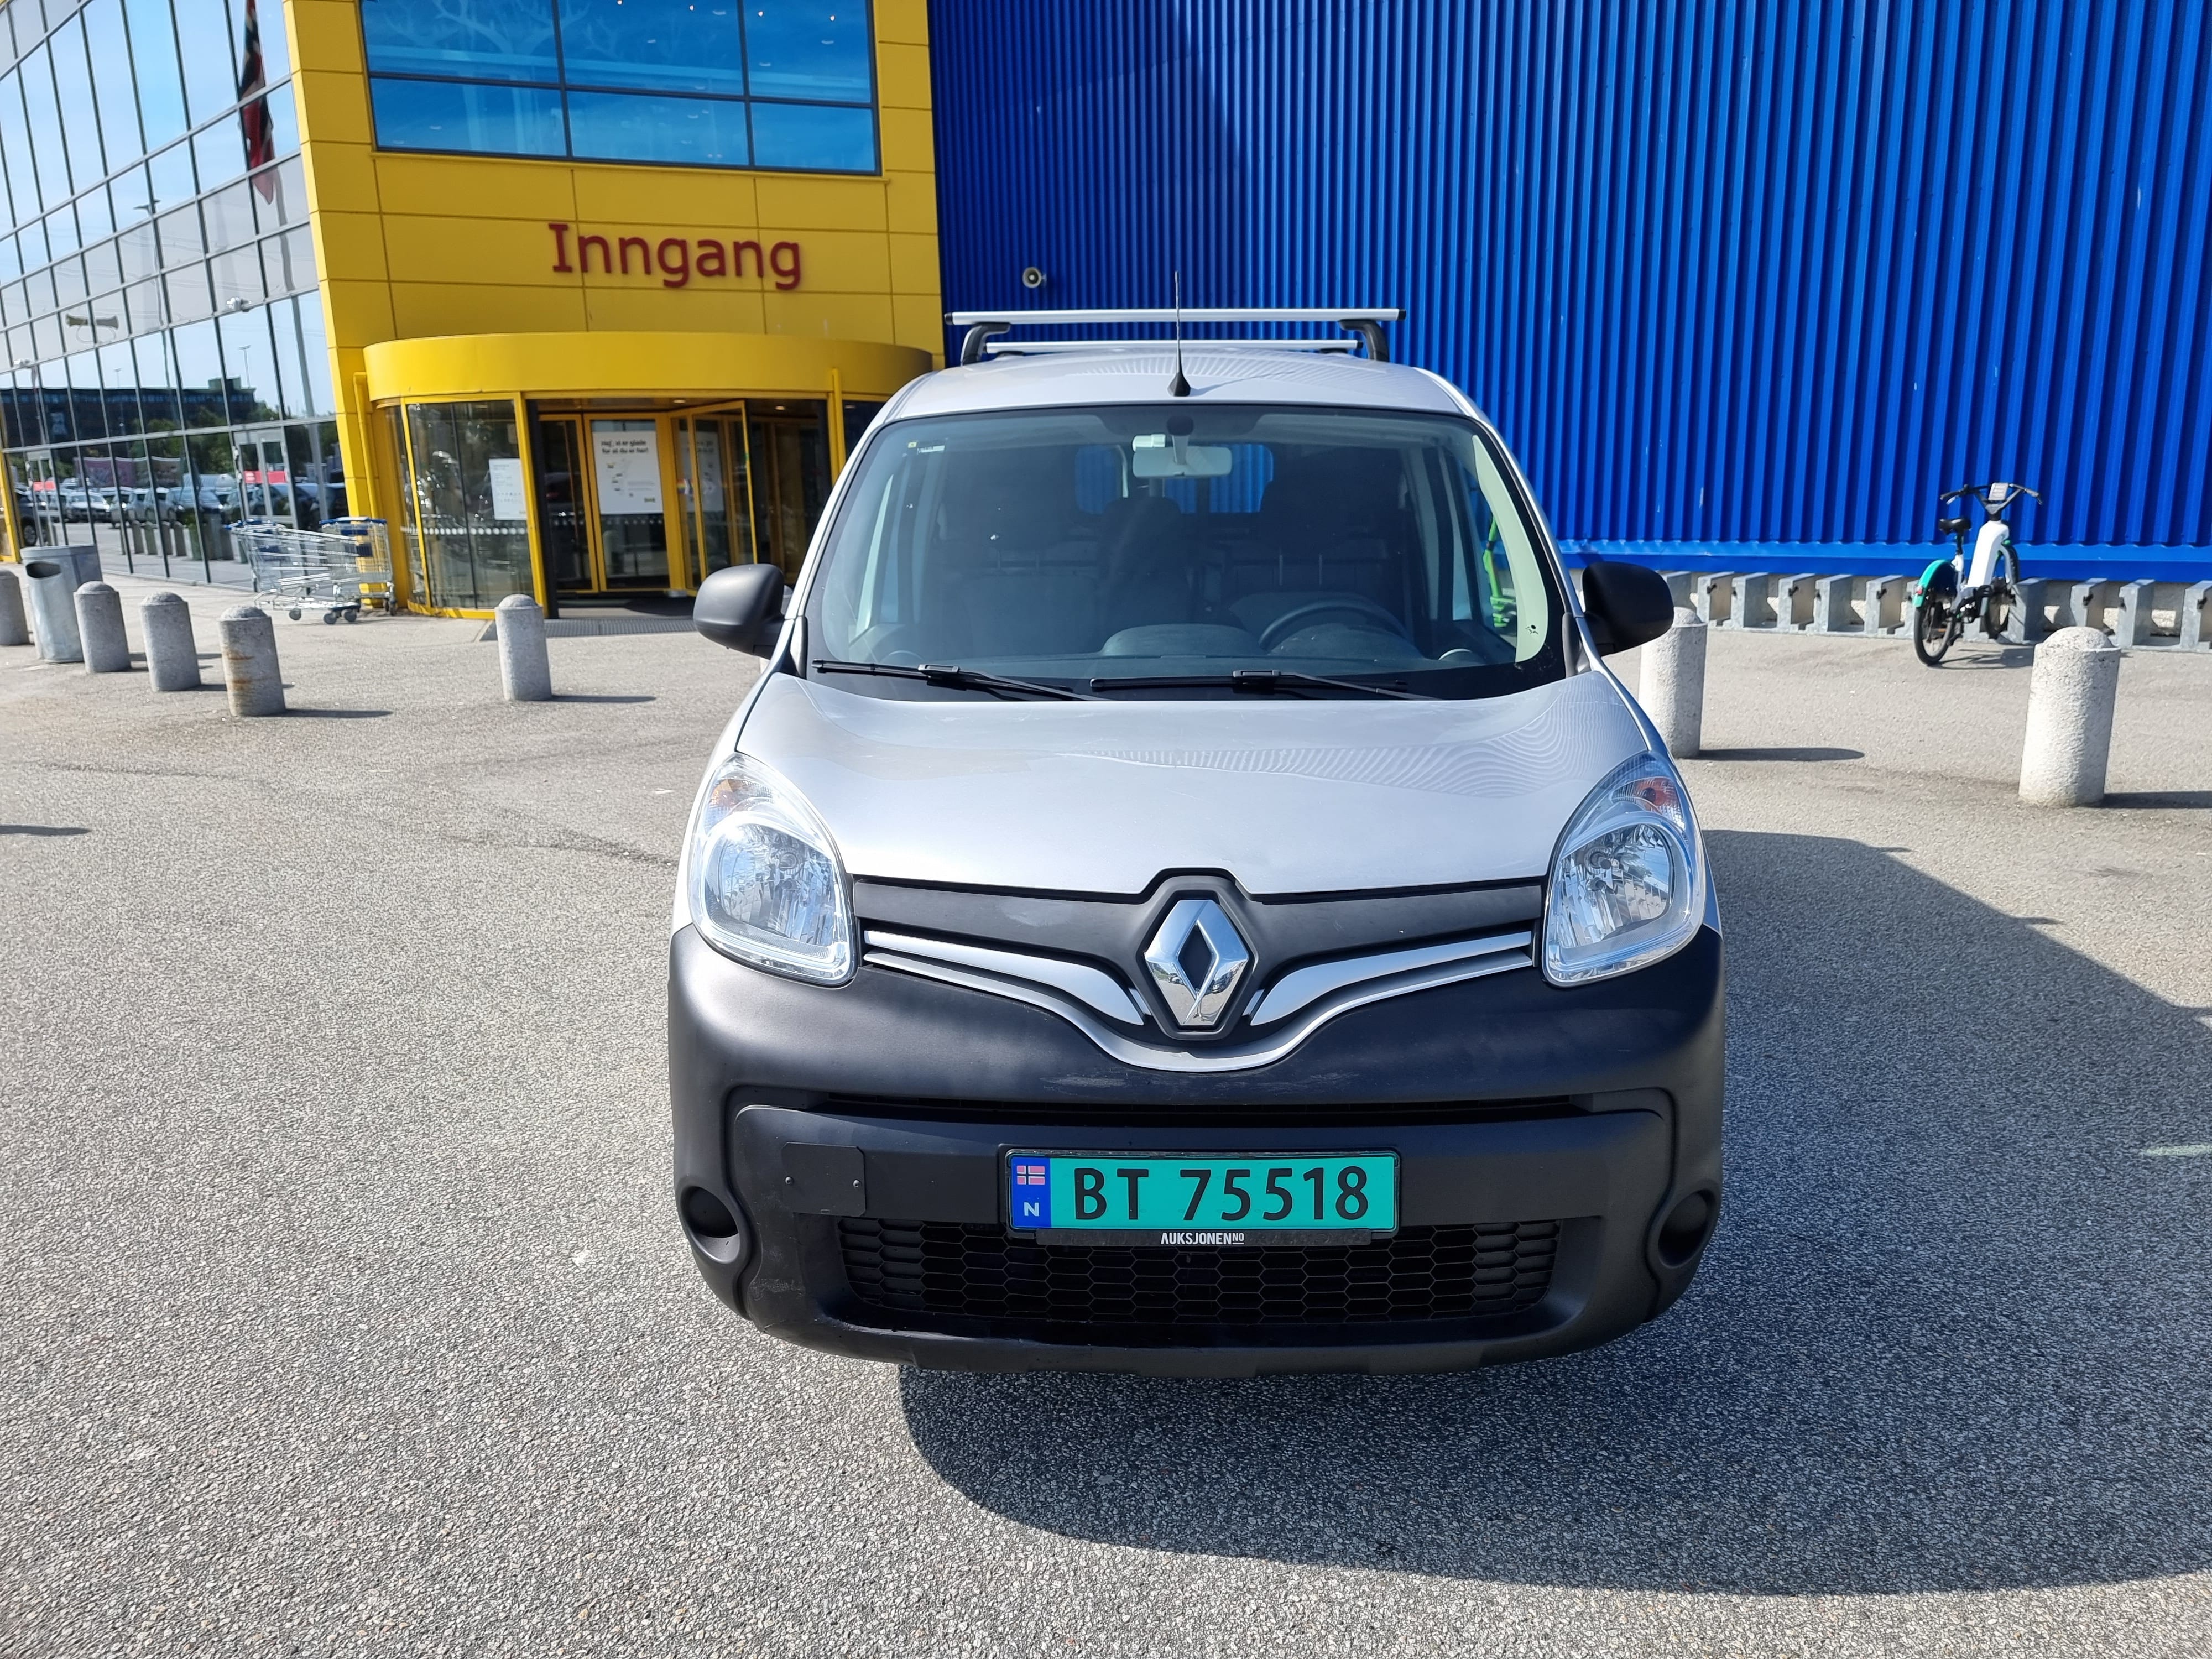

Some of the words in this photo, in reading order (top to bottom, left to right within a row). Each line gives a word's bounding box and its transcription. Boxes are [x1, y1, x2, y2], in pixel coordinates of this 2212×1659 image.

[549, 223, 801, 291] Inngang
[1023, 1201, 1040, 1217] N
[1074, 1167, 1149, 1220] BT
[1179, 1165, 1369, 1222] 75518
